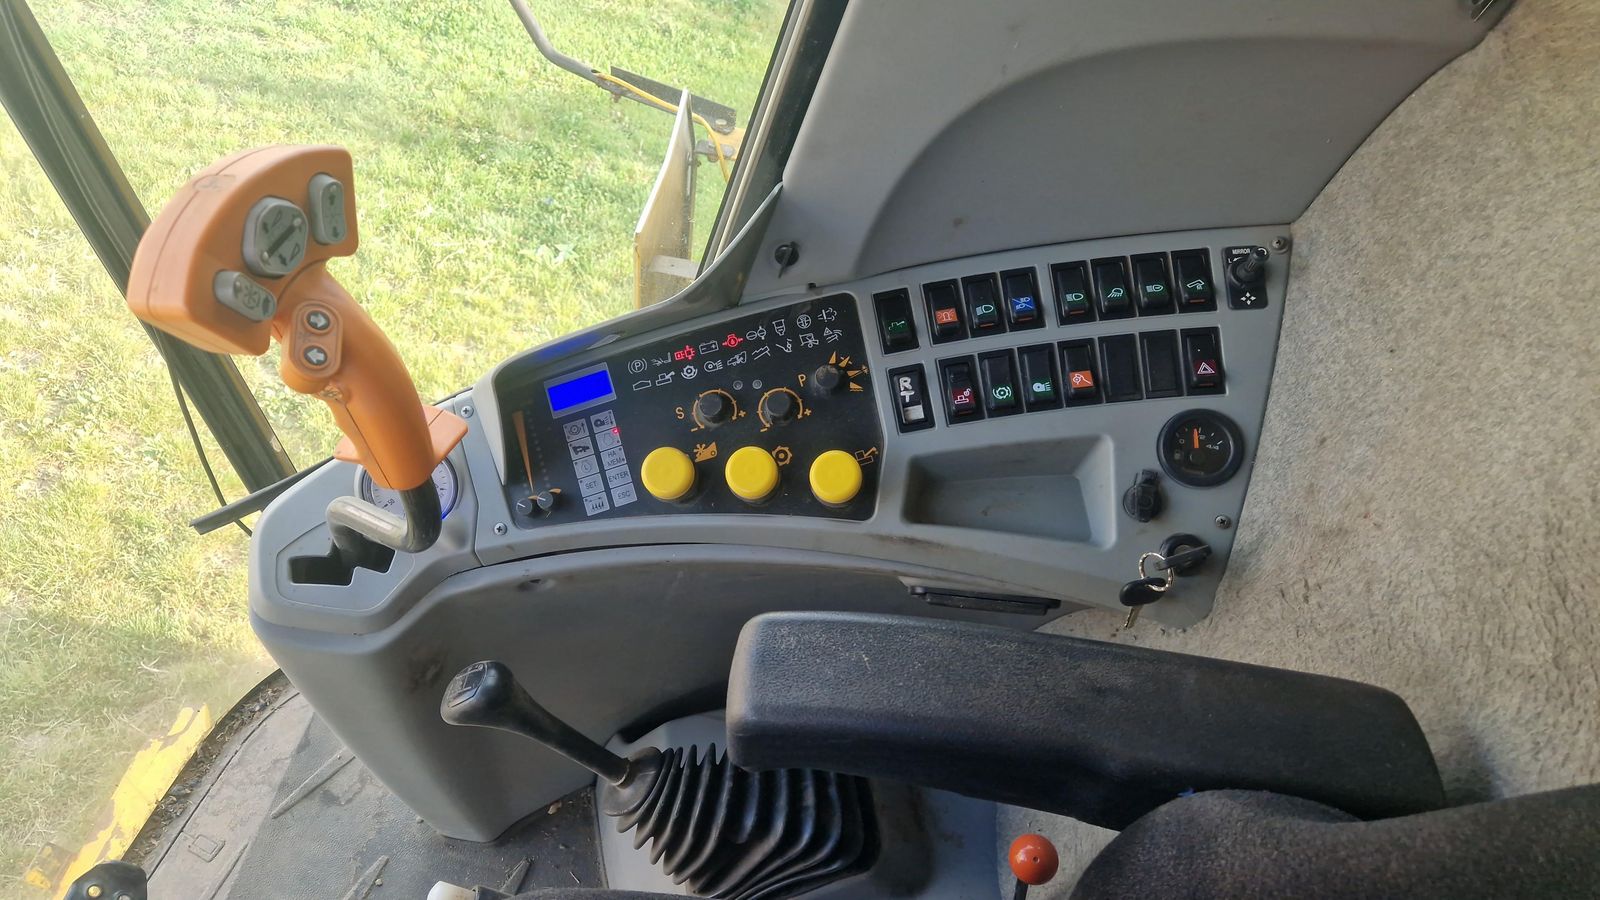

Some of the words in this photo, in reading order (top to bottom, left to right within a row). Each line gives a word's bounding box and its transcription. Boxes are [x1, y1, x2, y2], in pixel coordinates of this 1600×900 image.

[798, 374, 807, 387] P
[899, 376, 912, 390] R
[900, 390, 915, 402] T
[675, 406, 685, 420] S
[608, 470, 629, 483] ENTER
[585, 481, 597, 490] SET
[617, 490, 631, 499] ESC
